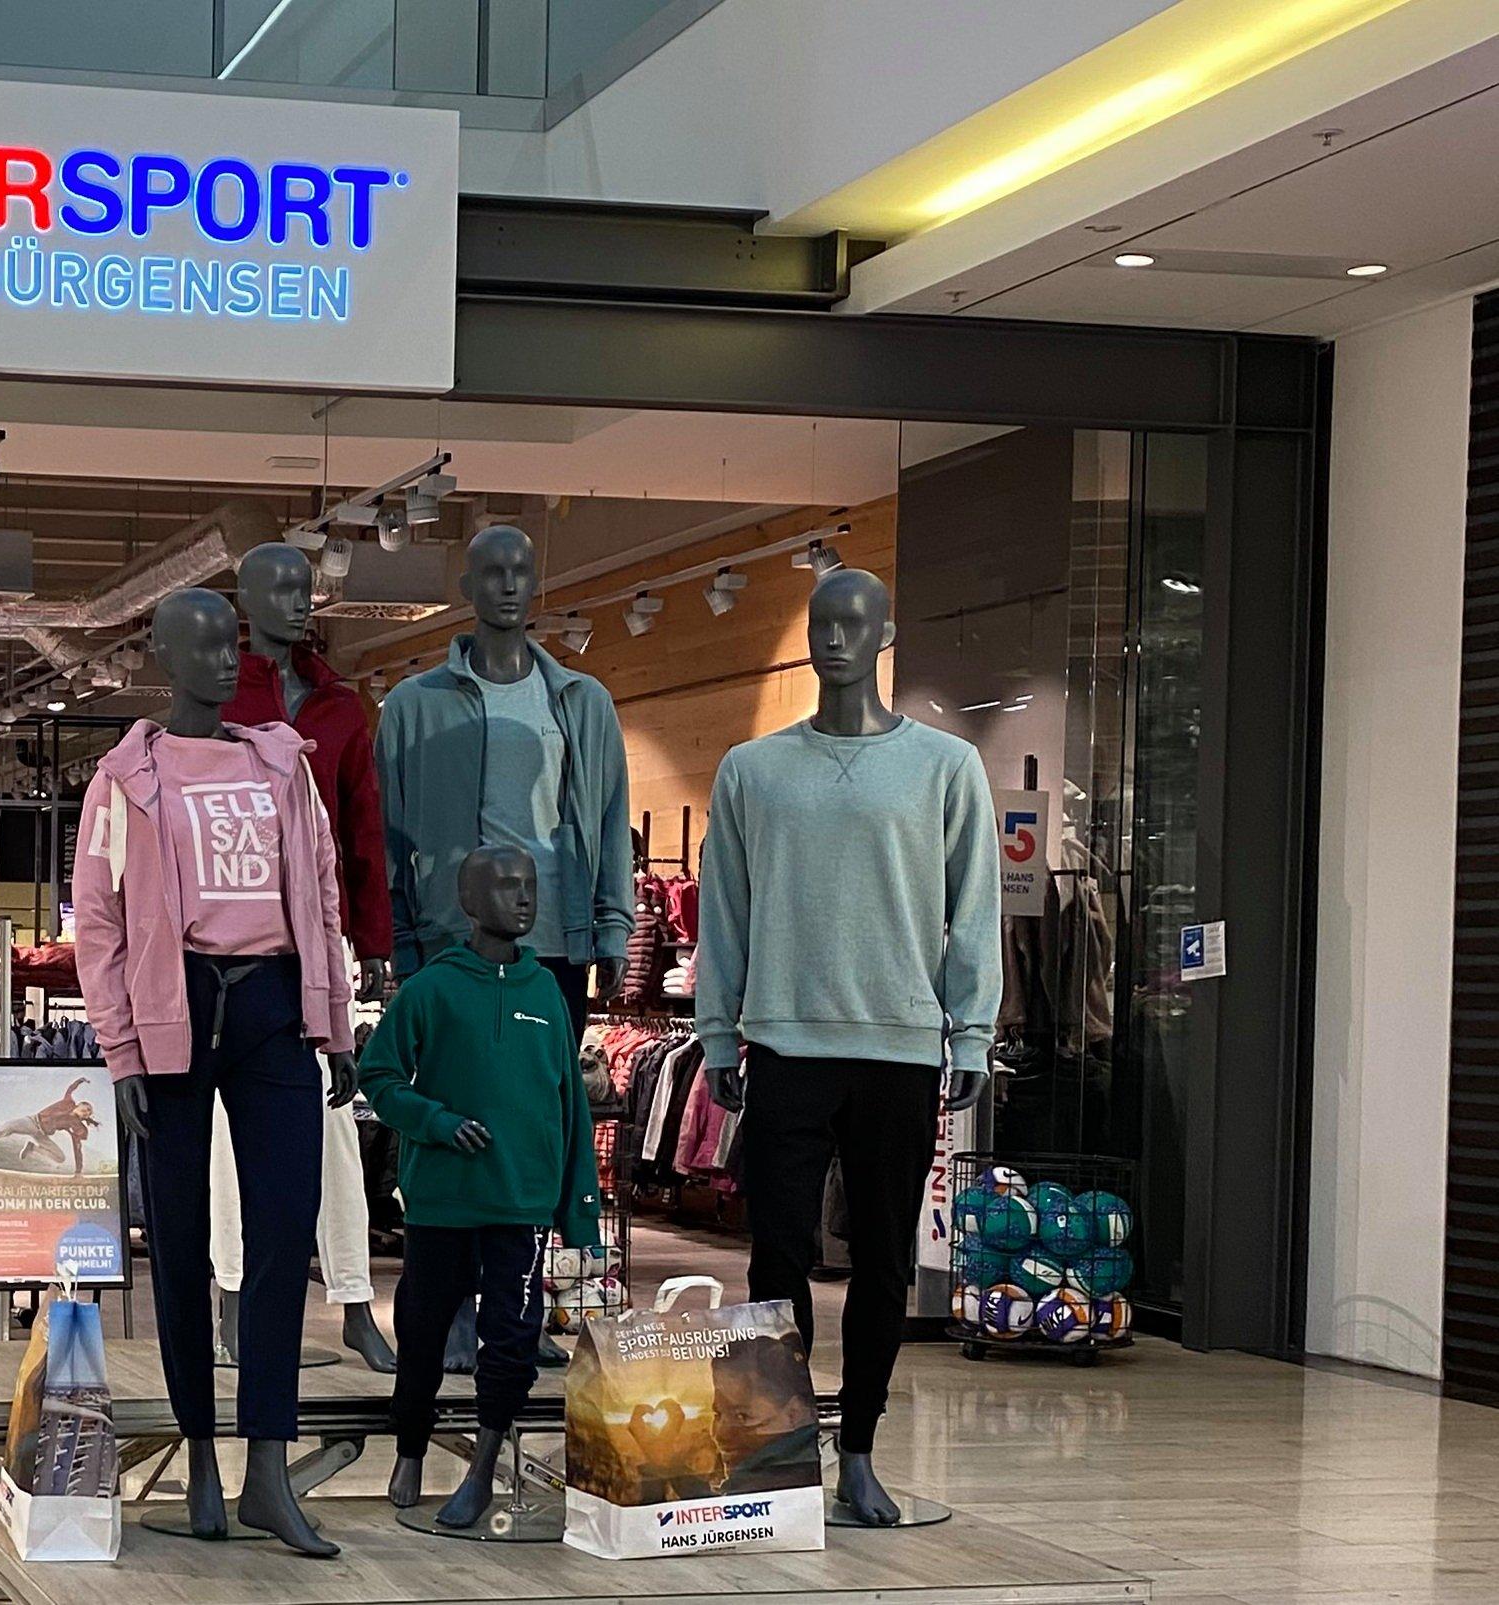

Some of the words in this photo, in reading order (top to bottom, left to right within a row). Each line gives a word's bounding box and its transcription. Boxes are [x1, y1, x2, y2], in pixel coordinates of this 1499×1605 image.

[203, 792, 277, 818] ELB
[63, 824, 76, 884] KABINE
[213, 853, 271, 887] ND
[1006, 872, 1035, 882] HANS
[1002, 884, 1030, 894] NSEN
[30, 1198, 43, 1210] IN
[45, 1198, 71, 1210] DEN
[74, 1198, 111, 1209] CLUB.
[60, 1245, 115, 1258] PUNKTE
[617, 1327, 757, 1354] SPORT-AUSRÜSTUNG
[672, 1346, 694, 1361] BEI
[696, 1343, 730, 1360] UNS!
[676, 1501, 774, 1526] INTERSPORT
[661, 1534, 698, 1549] HANS
[700, 1526, 775, 1545] JÜRGENSEN
